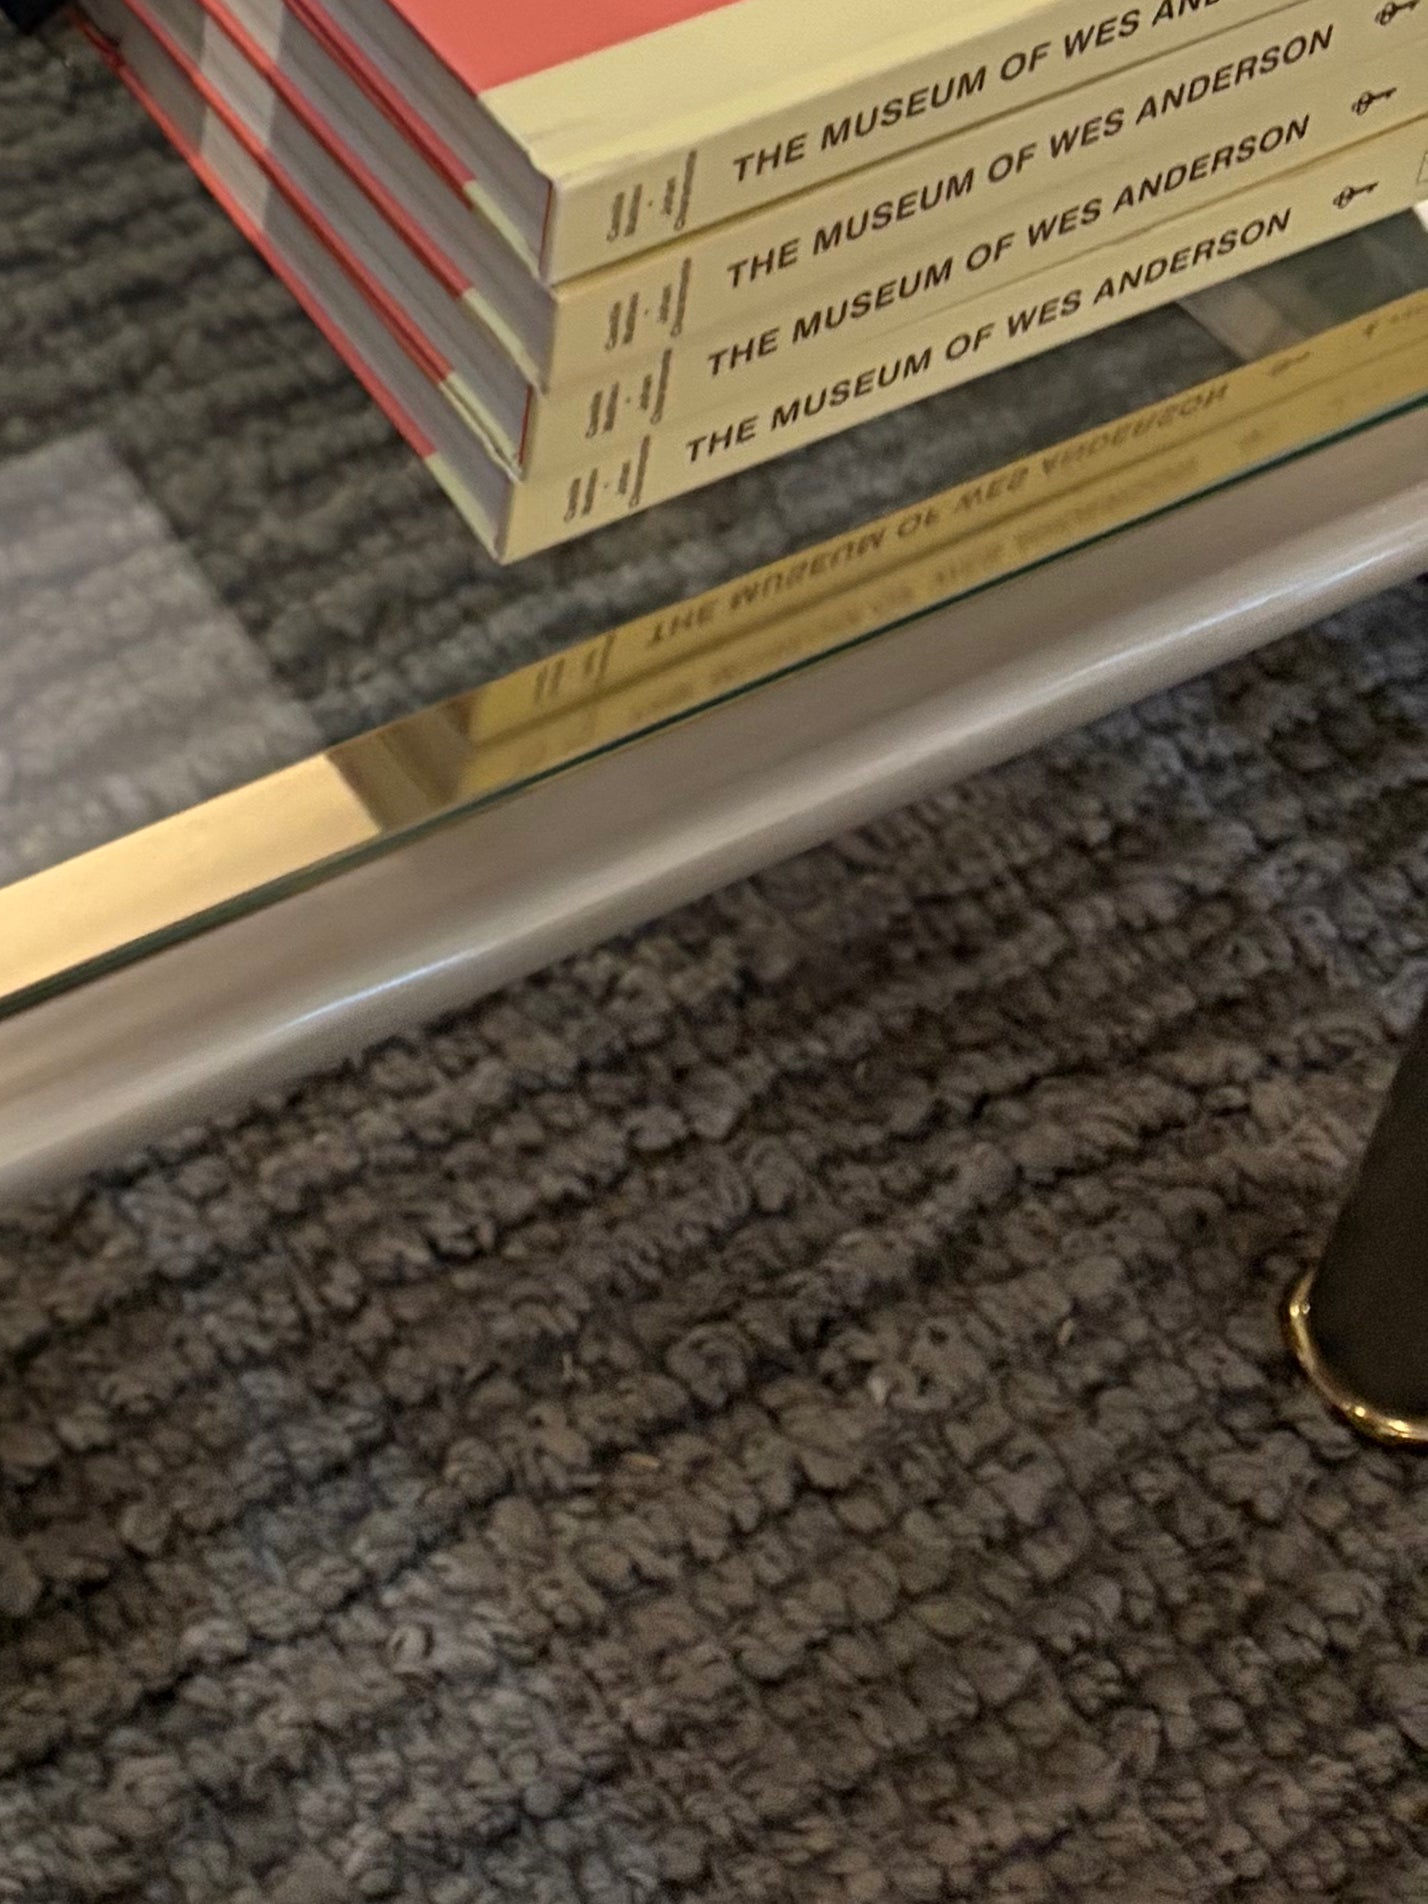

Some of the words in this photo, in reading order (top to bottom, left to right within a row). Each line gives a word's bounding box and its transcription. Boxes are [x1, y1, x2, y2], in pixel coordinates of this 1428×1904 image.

[726, 238, 800, 289] THE
[812, 167, 974, 256] MUSEUM
[987, 142, 1038, 184] OF
[1049, 106, 1126, 160] WES
[1135, 23, 1334, 125] ANDERSON
[732, 132, 808, 182] THE
[820, 65, 987, 151] MUSEUM
[1000, 42, 1051, 82] OF
[1063, 8, 1141, 60] WES
[686, 414, 759, 464] THE
[770, 346, 934, 433] MUSEUM
[944, 322, 996, 363] OF
[1006, 287, 1083, 340] WES
[1092, 207, 1292, 307] ANDERSON
[707, 326, 781, 377] THE
[791, 257, 953, 345] MUSEUM
[965, 232, 1017, 272] OF
[1027, 196, 1102, 249] WES
[1111, 114, 1310, 215] ANDERSON
